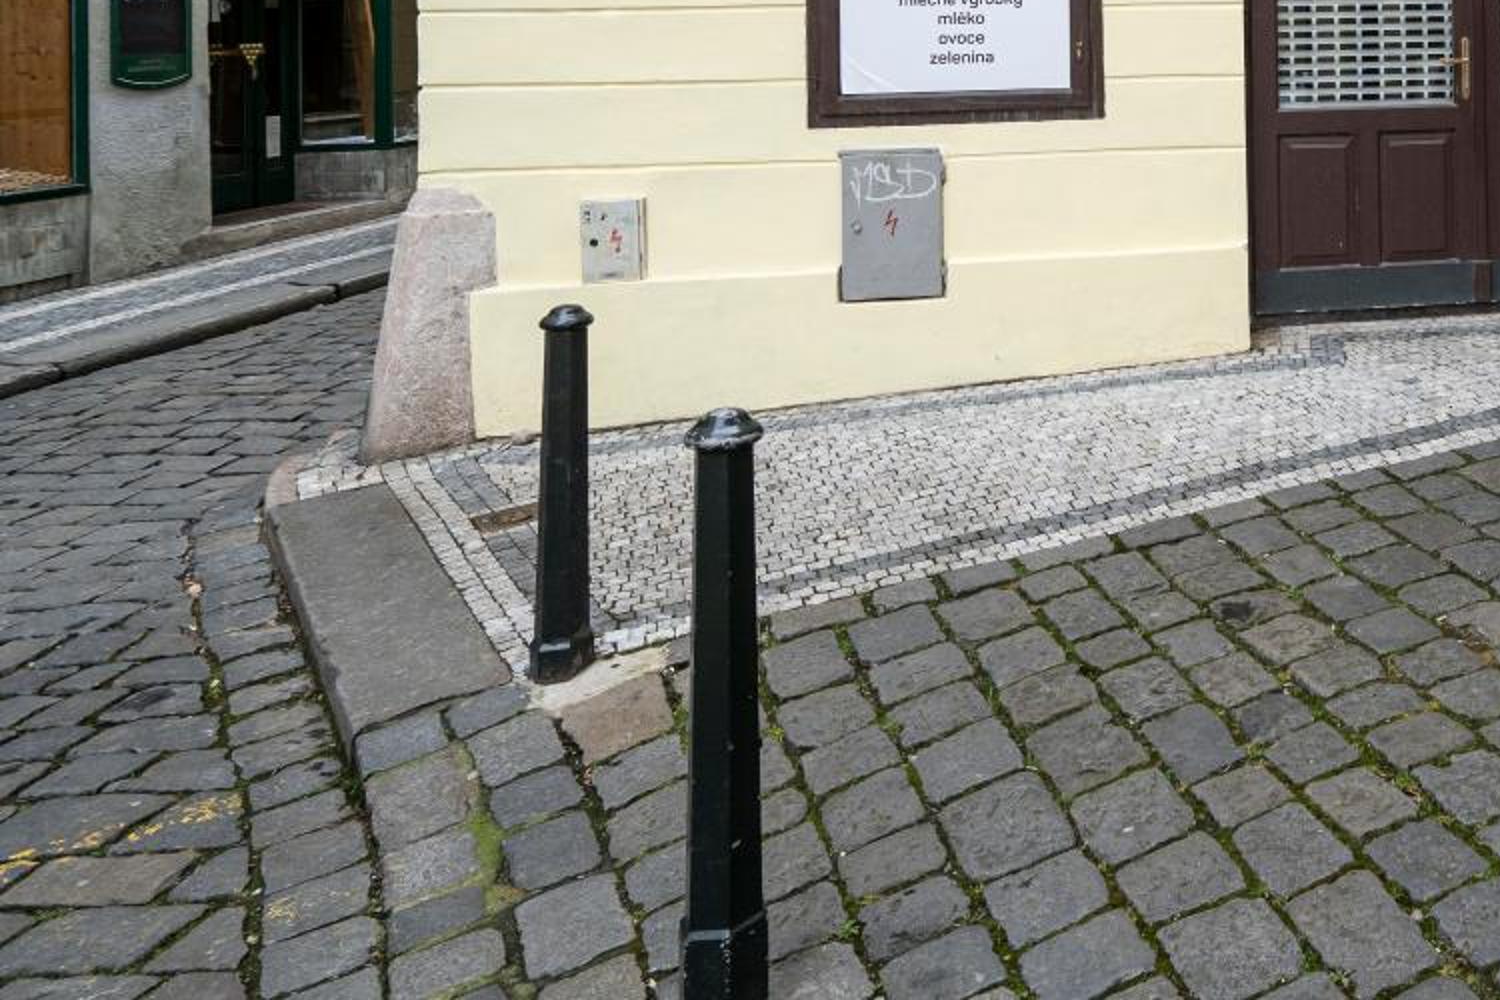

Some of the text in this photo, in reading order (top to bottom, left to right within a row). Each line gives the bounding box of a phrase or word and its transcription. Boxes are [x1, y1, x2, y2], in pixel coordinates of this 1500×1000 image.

[937, 11, 985, 25] mléko
[938, 33, 985, 45] ovoce
[929, 50, 995, 65] zelenina
